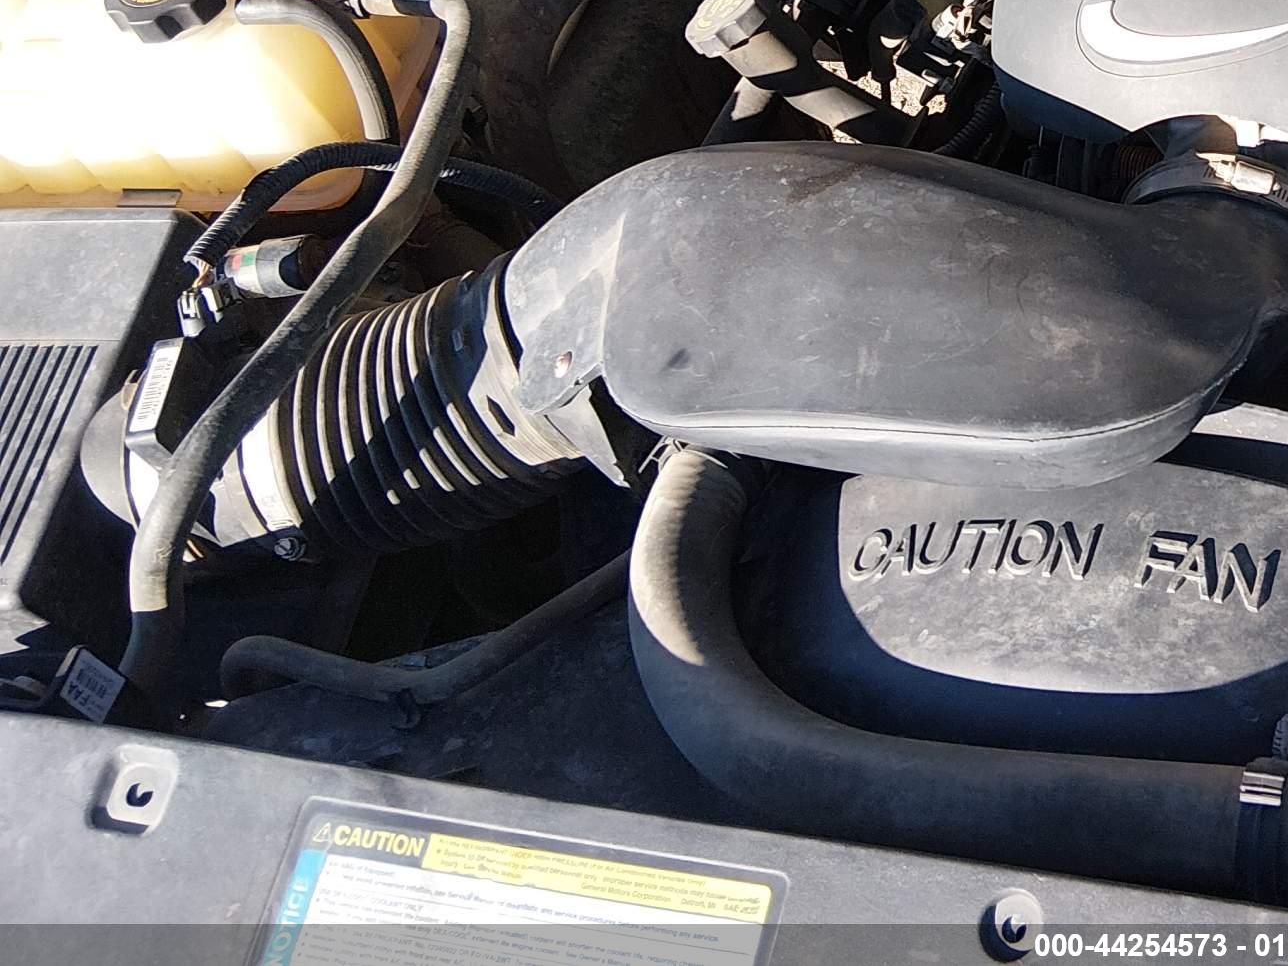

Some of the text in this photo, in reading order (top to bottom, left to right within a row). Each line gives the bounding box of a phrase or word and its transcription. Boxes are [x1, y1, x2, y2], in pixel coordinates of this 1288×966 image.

[848, 519, 1282, 612] CAUTION FAN
[333, 825, 425, 857] CAUTION
